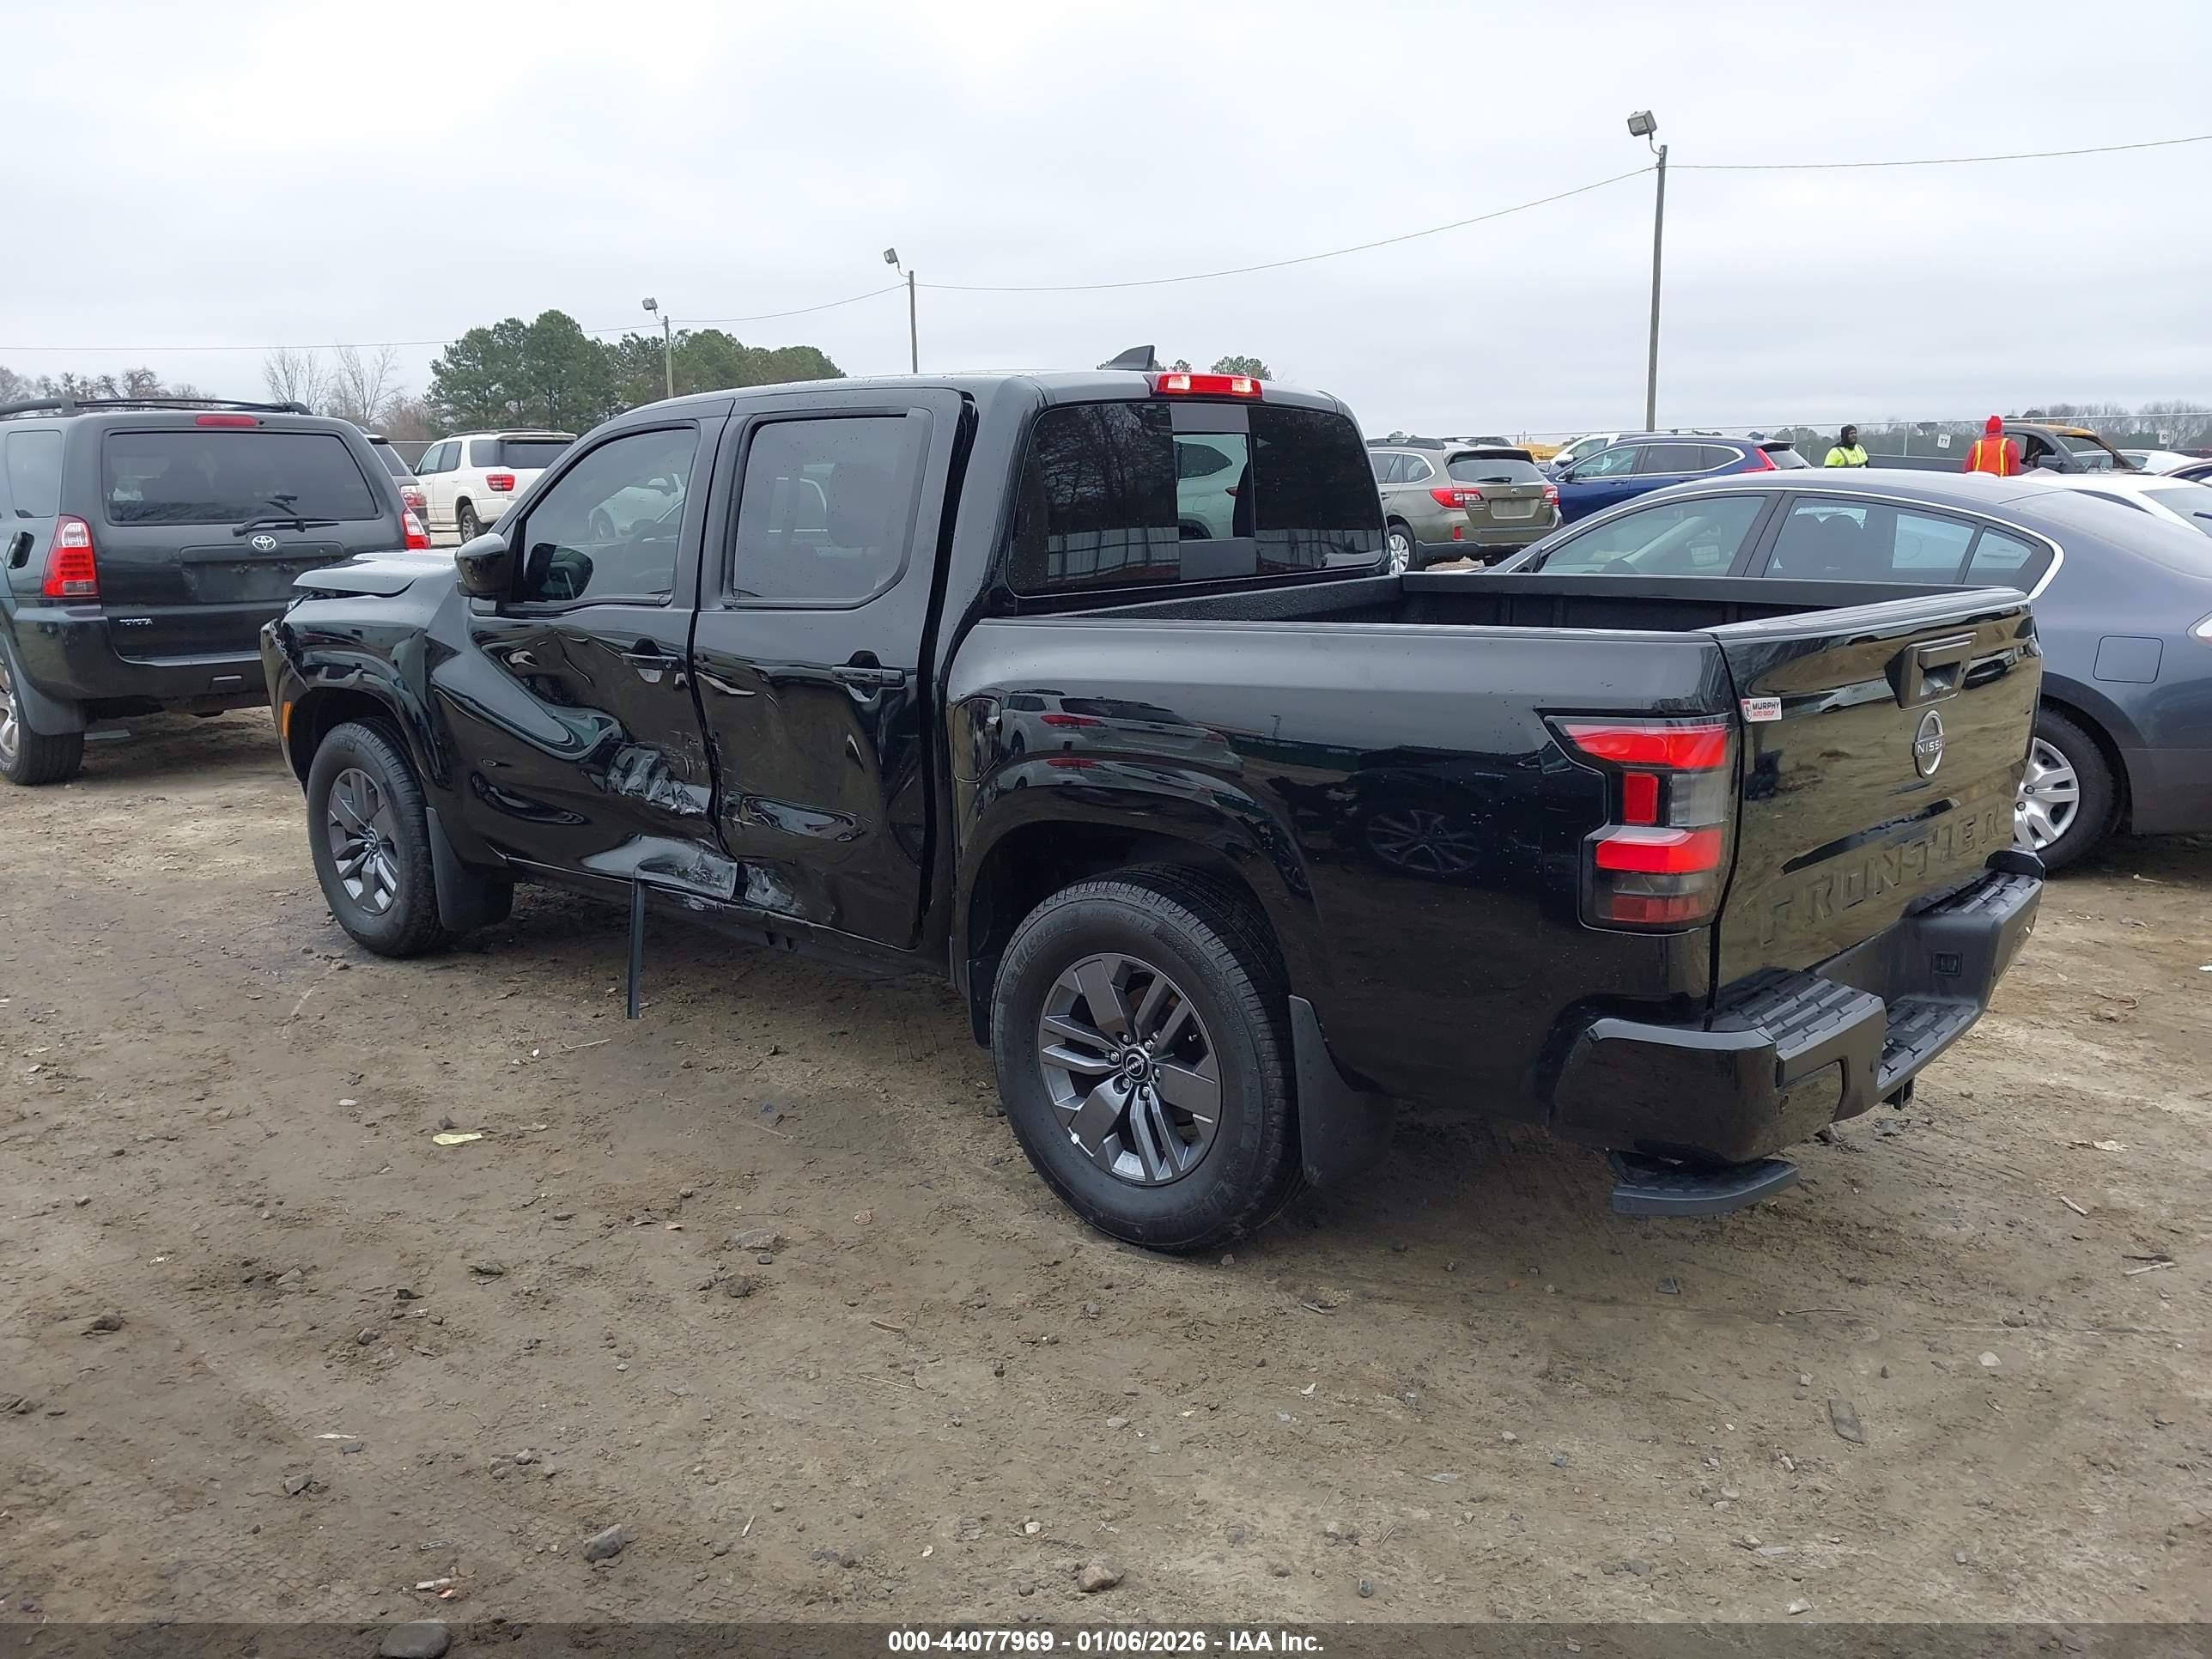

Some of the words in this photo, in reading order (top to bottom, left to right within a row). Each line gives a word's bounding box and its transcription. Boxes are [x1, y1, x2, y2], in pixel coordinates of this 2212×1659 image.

[1753, 701, 1780, 710] MURPHY
[1917, 738, 1944, 754] NISS
[1760, 802, 2002, 948] FRONTIER
